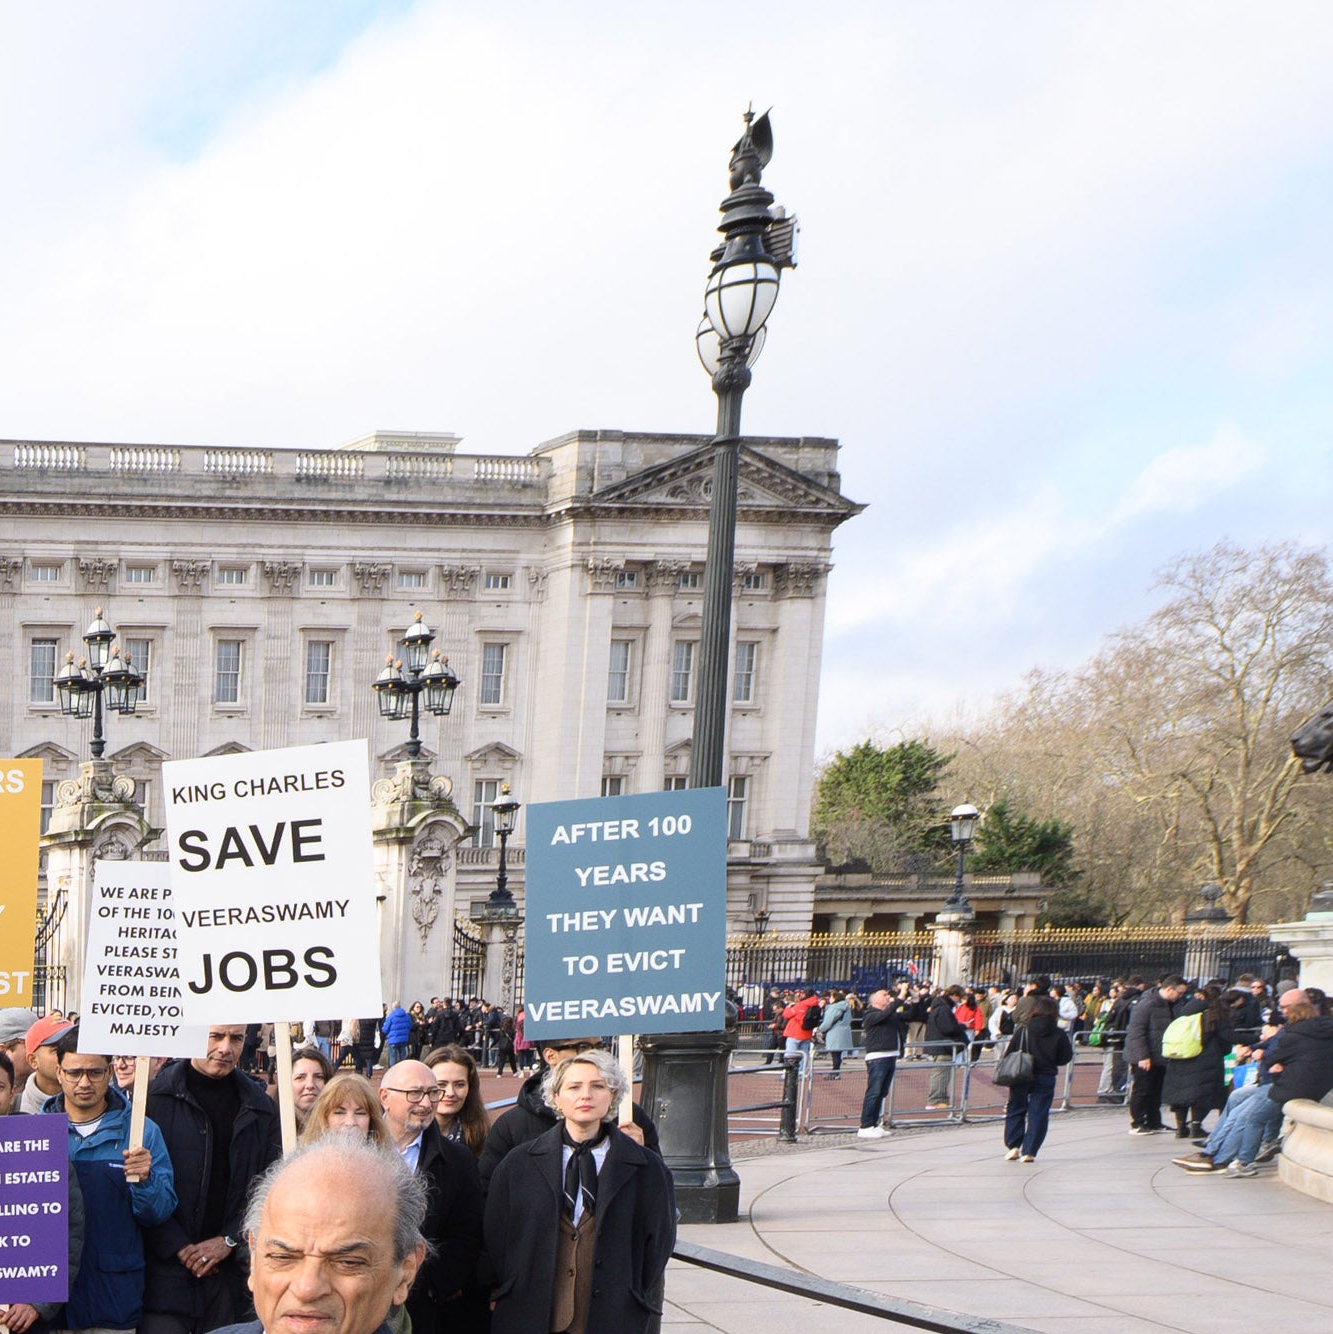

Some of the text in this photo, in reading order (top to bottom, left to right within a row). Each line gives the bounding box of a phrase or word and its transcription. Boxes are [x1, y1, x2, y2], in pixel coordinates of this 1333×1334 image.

[173, 770, 344, 804] KING CHARLES
[551, 815, 691, 845] AFTER 100
[179, 819, 325, 872] SAVE
[575, 861, 666, 886] YEARS
[101, 887, 124, 898] WE
[128, 888, 158, 899] ARE
[99, 907, 150, 919] OF THE
[182, 900, 349, 927] VEERASWAMY
[547, 903, 703, 932] THEY WANT
[105, 946, 157, 958] PLEASE
[188, 946, 337, 994] JOBS
[563, 949, 685, 975] TO EVICT
[100, 984, 144, 996] FROM
[528, 992, 721, 1021] VEERASWAMY
[110, 1023, 179, 1036] MAJESTY
[24, 1139, 49, 1151] THE
[5, 1171, 60, 1184] ESTATES
[42, 1202, 61, 1214] TO
[11, 1235, 31, 1247] TO
